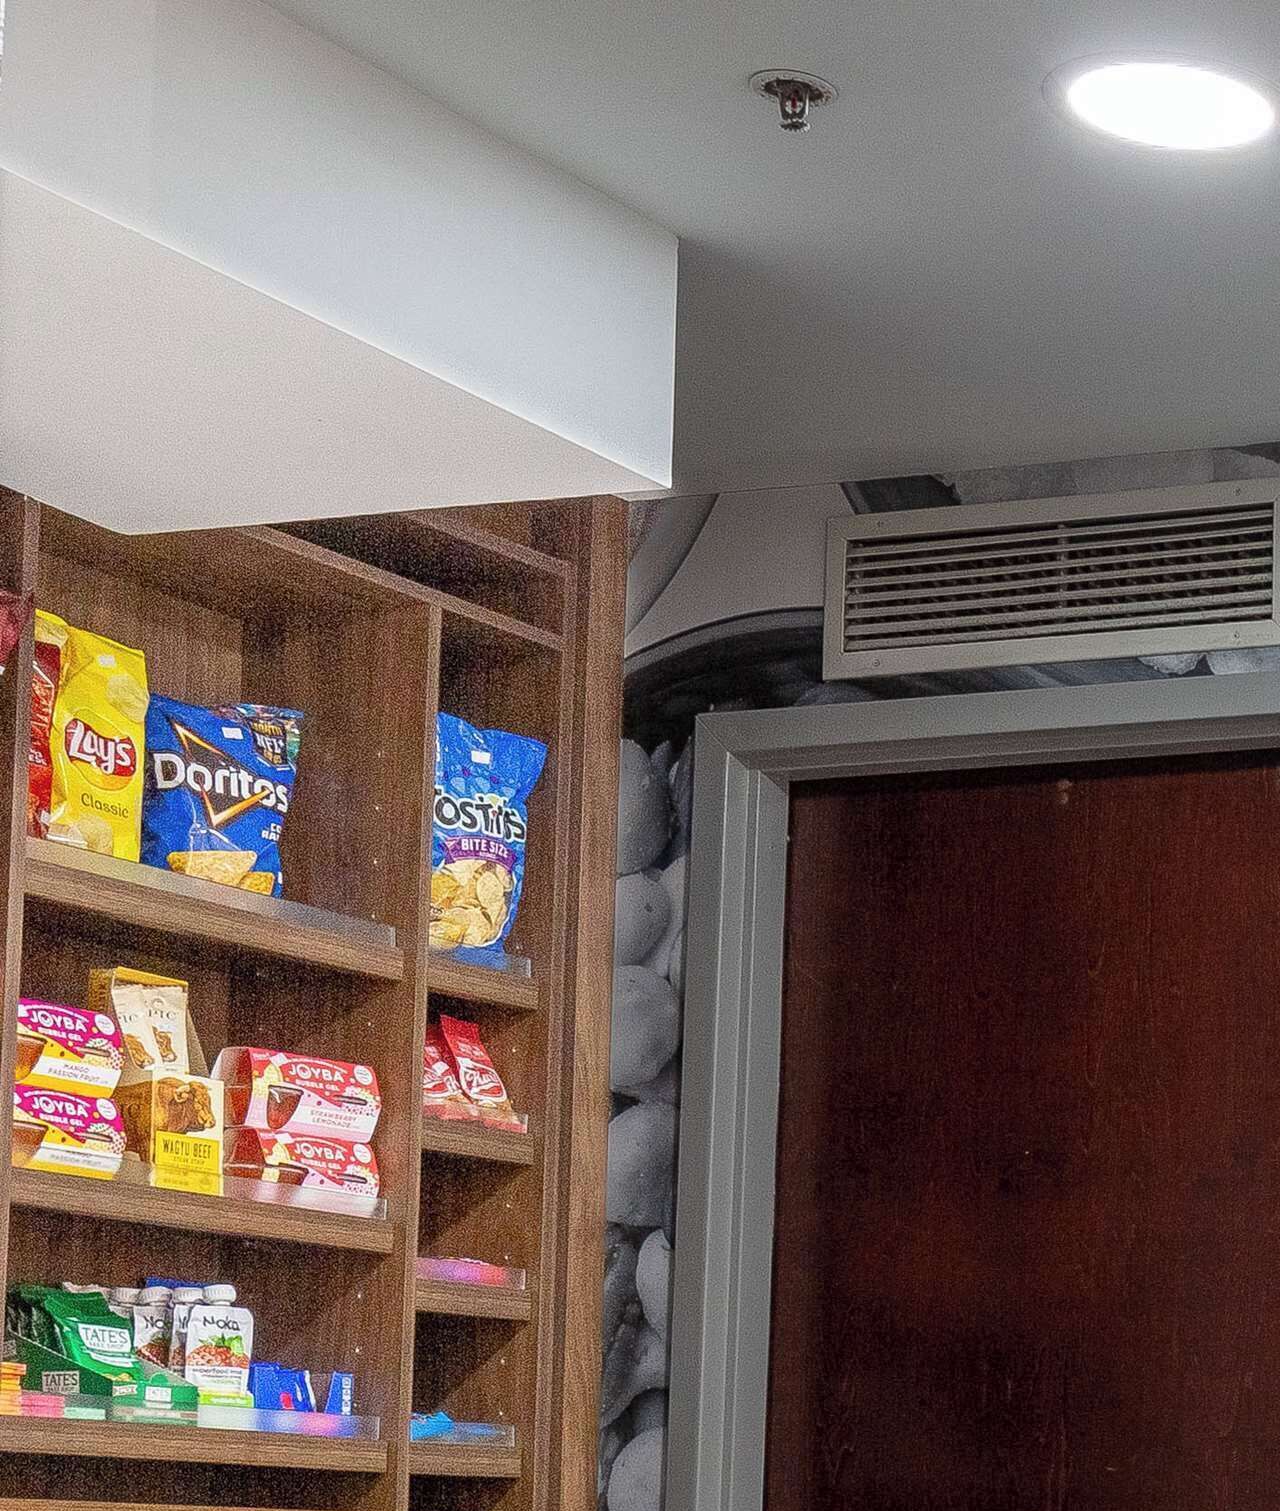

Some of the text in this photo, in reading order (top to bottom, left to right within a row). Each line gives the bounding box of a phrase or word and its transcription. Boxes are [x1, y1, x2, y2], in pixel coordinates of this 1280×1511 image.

[68, 722, 133, 774] Lay's
[152, 752, 289, 813] Doritos
[81, 793, 129, 819] Classic
[461, 838, 509, 858] BITE SIZE
[30, 1010, 87, 1033] JOYBA
[289, 1063, 345, 1083] JOYBA
[31, 1097, 88, 1118] JOYBA
[163, 1139, 212, 1159] WAGYU BEEF
[295, 1143, 345, 1161] JOYBA
